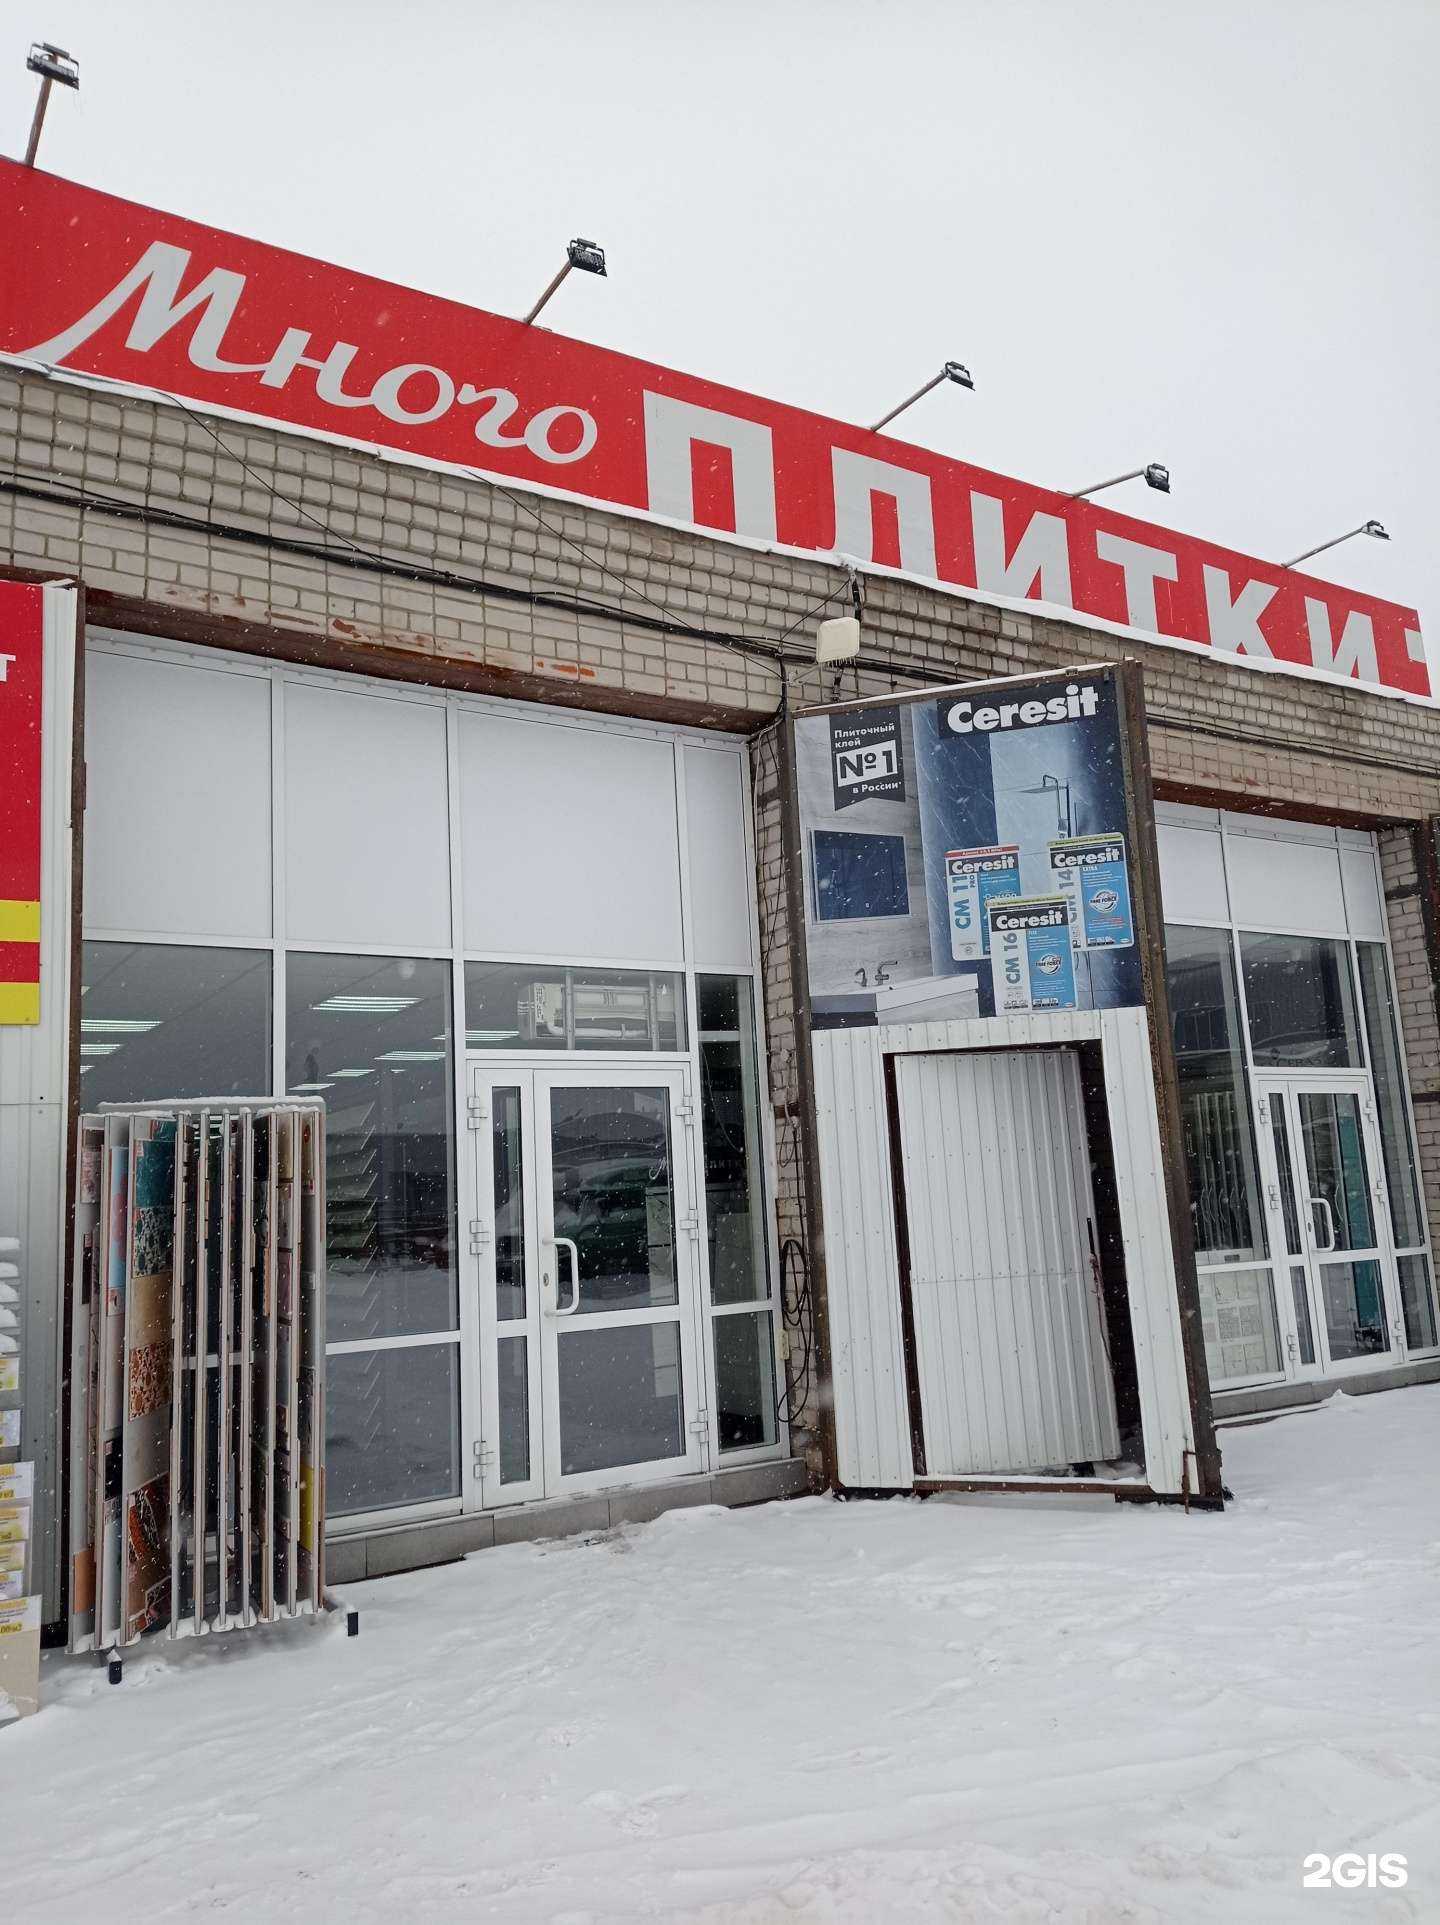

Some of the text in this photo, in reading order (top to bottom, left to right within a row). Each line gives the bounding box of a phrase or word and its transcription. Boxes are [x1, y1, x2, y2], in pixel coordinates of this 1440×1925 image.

[18, 240, 1381, 684] Много ПЛИТКИ
[947, 684, 1098, 734] Ceresit
[834, 723, 895, 738] Плиточный
[834, 738, 861, 748] клей
[852, 786, 859, 794] в
[951, 856, 1015, 874] Ceresit
[1053, 848, 1120, 868] Ceresit
[951, 875, 969, 893] 11
[1058, 869, 1074, 889] 14
[954, 898, 972, 929] CM
[996, 910, 1063, 929] Ceresit
[1003, 932, 1018, 952] 16
[1005, 957, 1021, 984] CM
